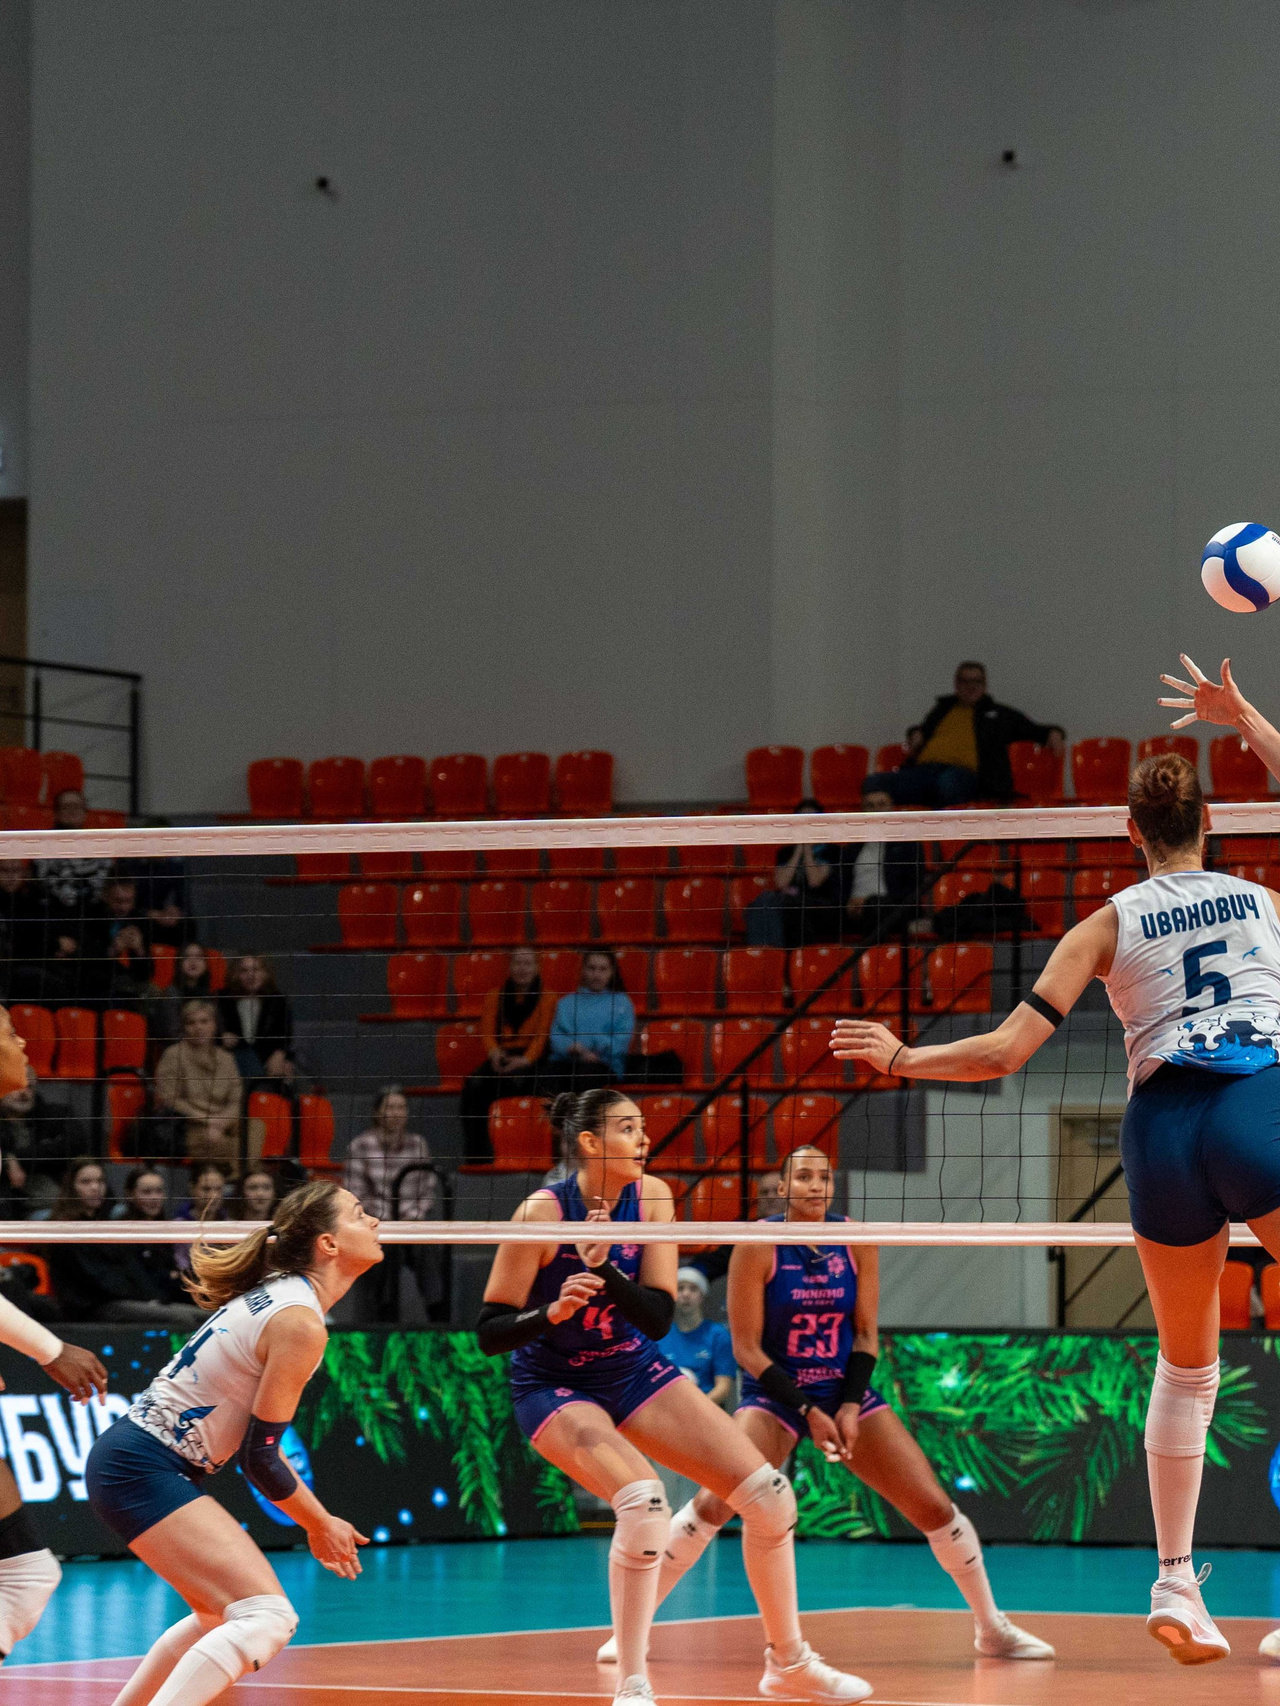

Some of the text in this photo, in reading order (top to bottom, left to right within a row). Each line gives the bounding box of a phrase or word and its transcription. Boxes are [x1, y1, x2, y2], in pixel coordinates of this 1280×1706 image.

[1140, 893, 1261, 940] ИВАНОВИЧ
[1182, 940, 1232, 1018] 5
[582, 1303, 617, 1340] 4
[786, 1312, 845, 1359] 23
